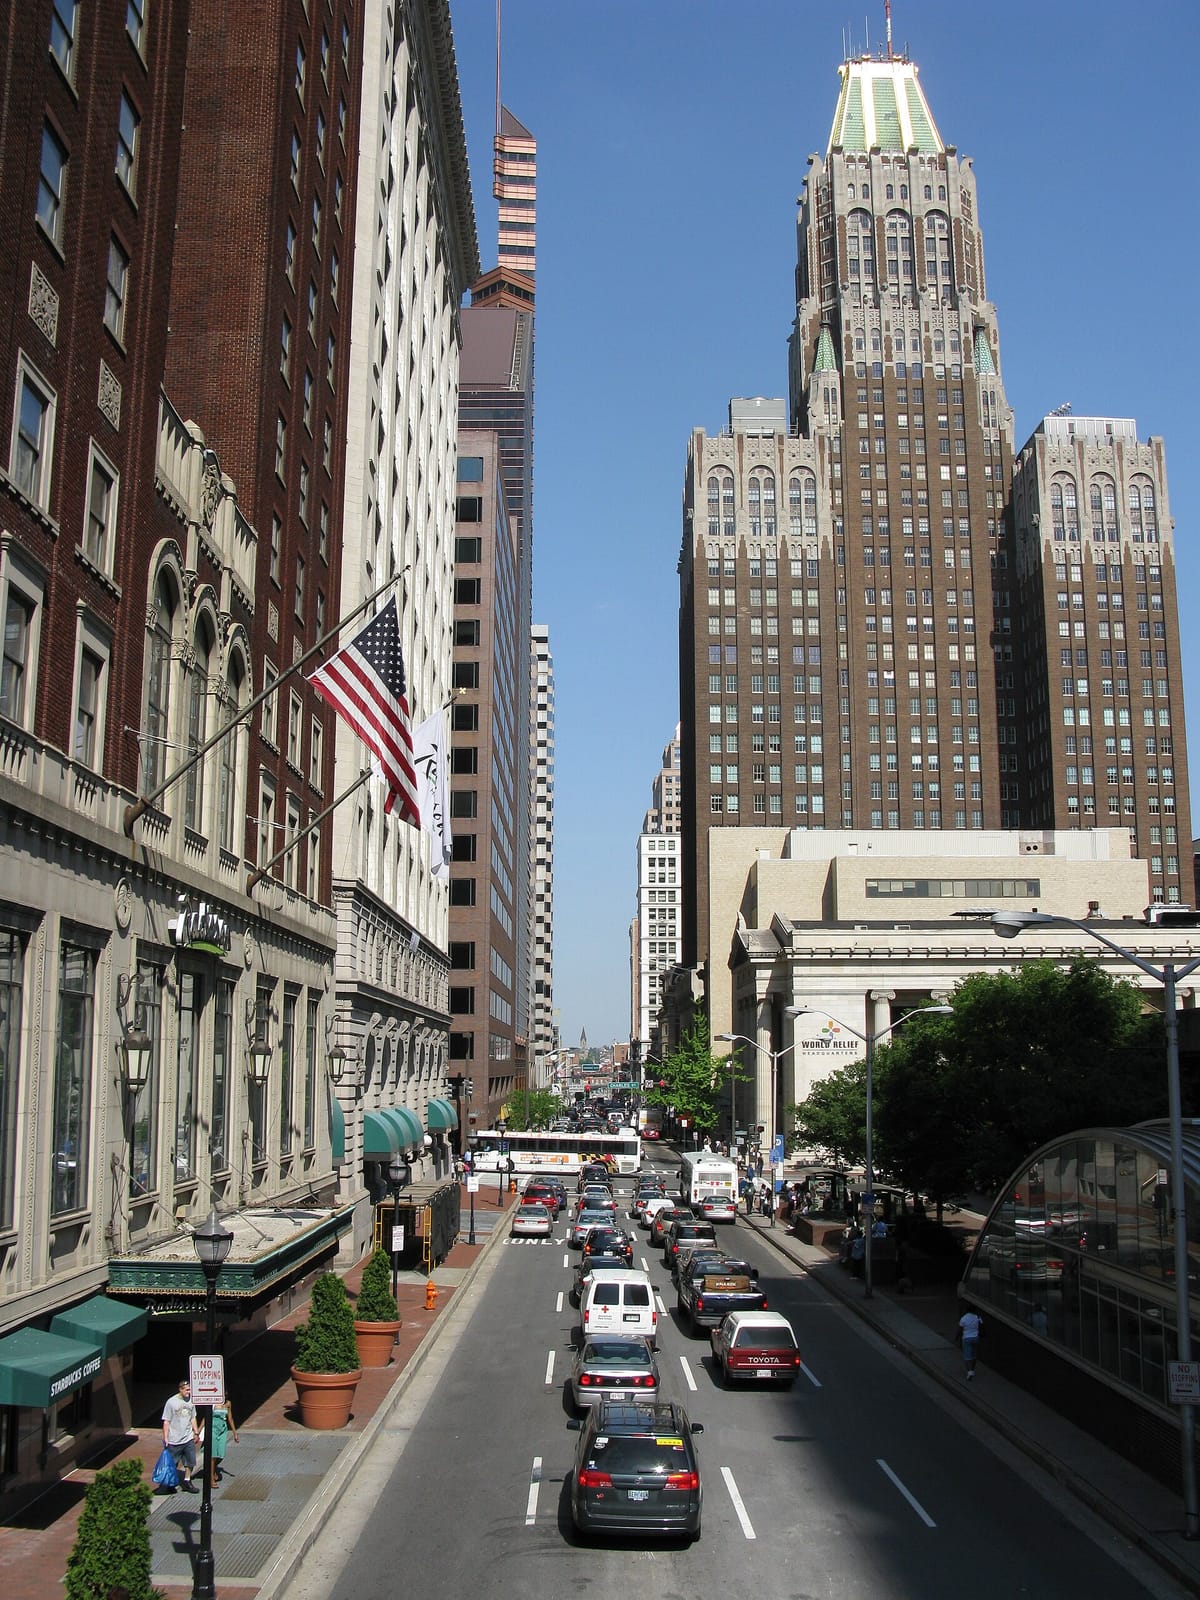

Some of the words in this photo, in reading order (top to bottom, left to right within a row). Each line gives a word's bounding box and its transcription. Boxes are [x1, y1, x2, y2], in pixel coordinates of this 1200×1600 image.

[200, 1360, 213, 1369] NO
[1177, 1364, 1190, 1373] NO
[50, 1367, 82, 1397] STARBUCKS
[83, 1356, 101, 1377] COFFEE
[193, 1370, 221, 1380] STOPPING
